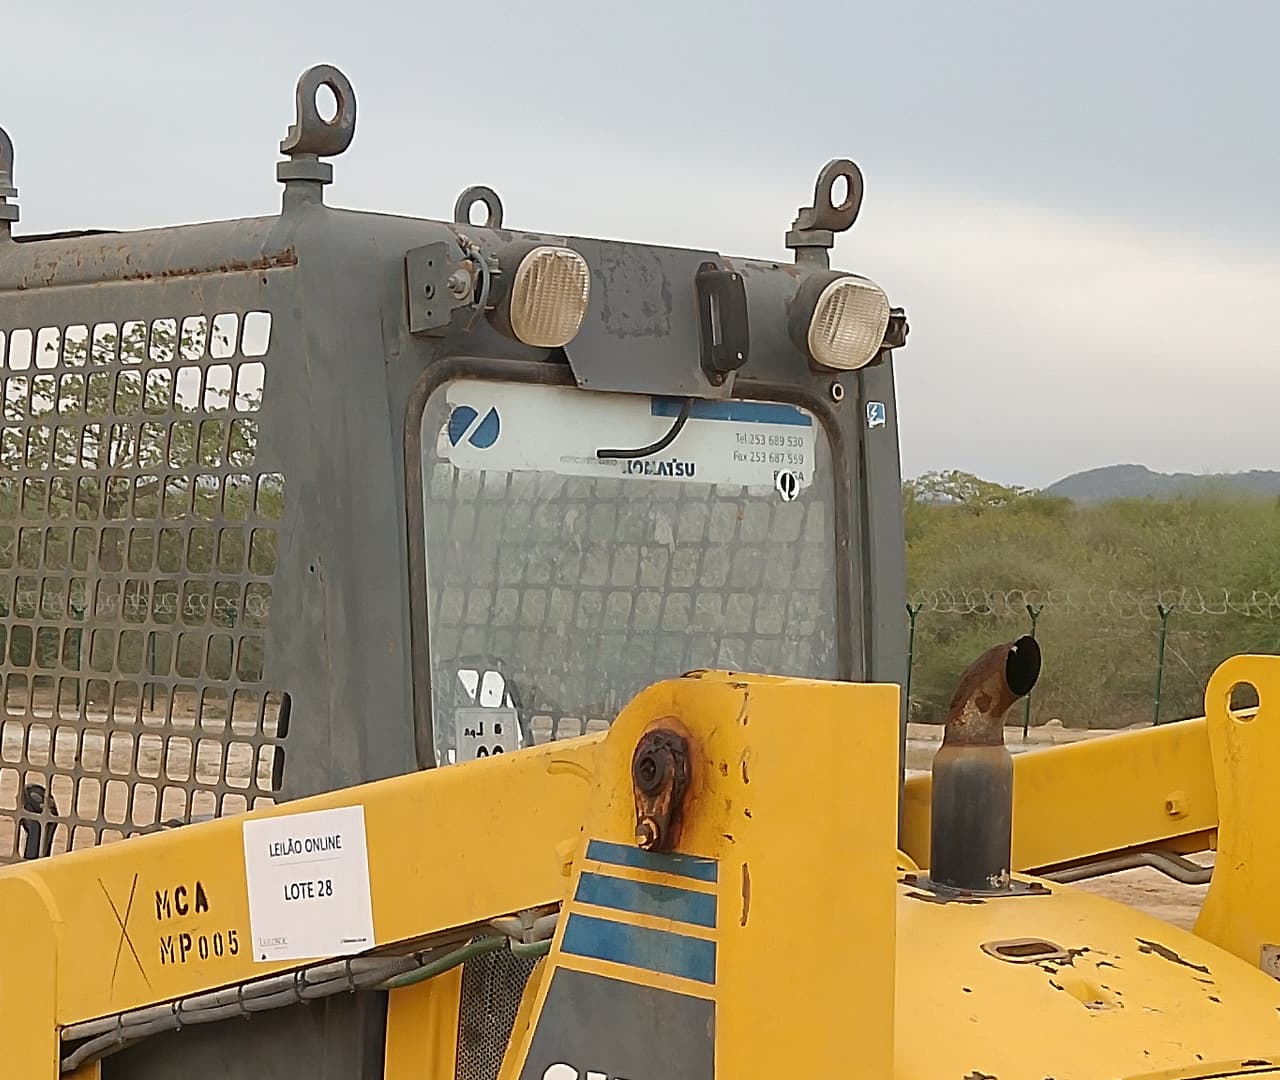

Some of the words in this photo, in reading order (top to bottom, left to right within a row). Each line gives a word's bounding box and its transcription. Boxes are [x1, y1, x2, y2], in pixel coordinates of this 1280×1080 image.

[749, 434, 766, 446] 253
[768, 435, 785, 447] 689
[787, 436, 804, 448] 530
[733, 451, 747, 462] Fax
[750, 451, 766, 463] 253
[269, 837, 303, 857] LEILÃO
[304, 834, 342, 853] ONLINE
[154, 880, 210, 921] MCA
[284, 881, 315, 901] LOTE
[317, 879, 333, 897] 28
[159, 929, 240, 965] MP005
